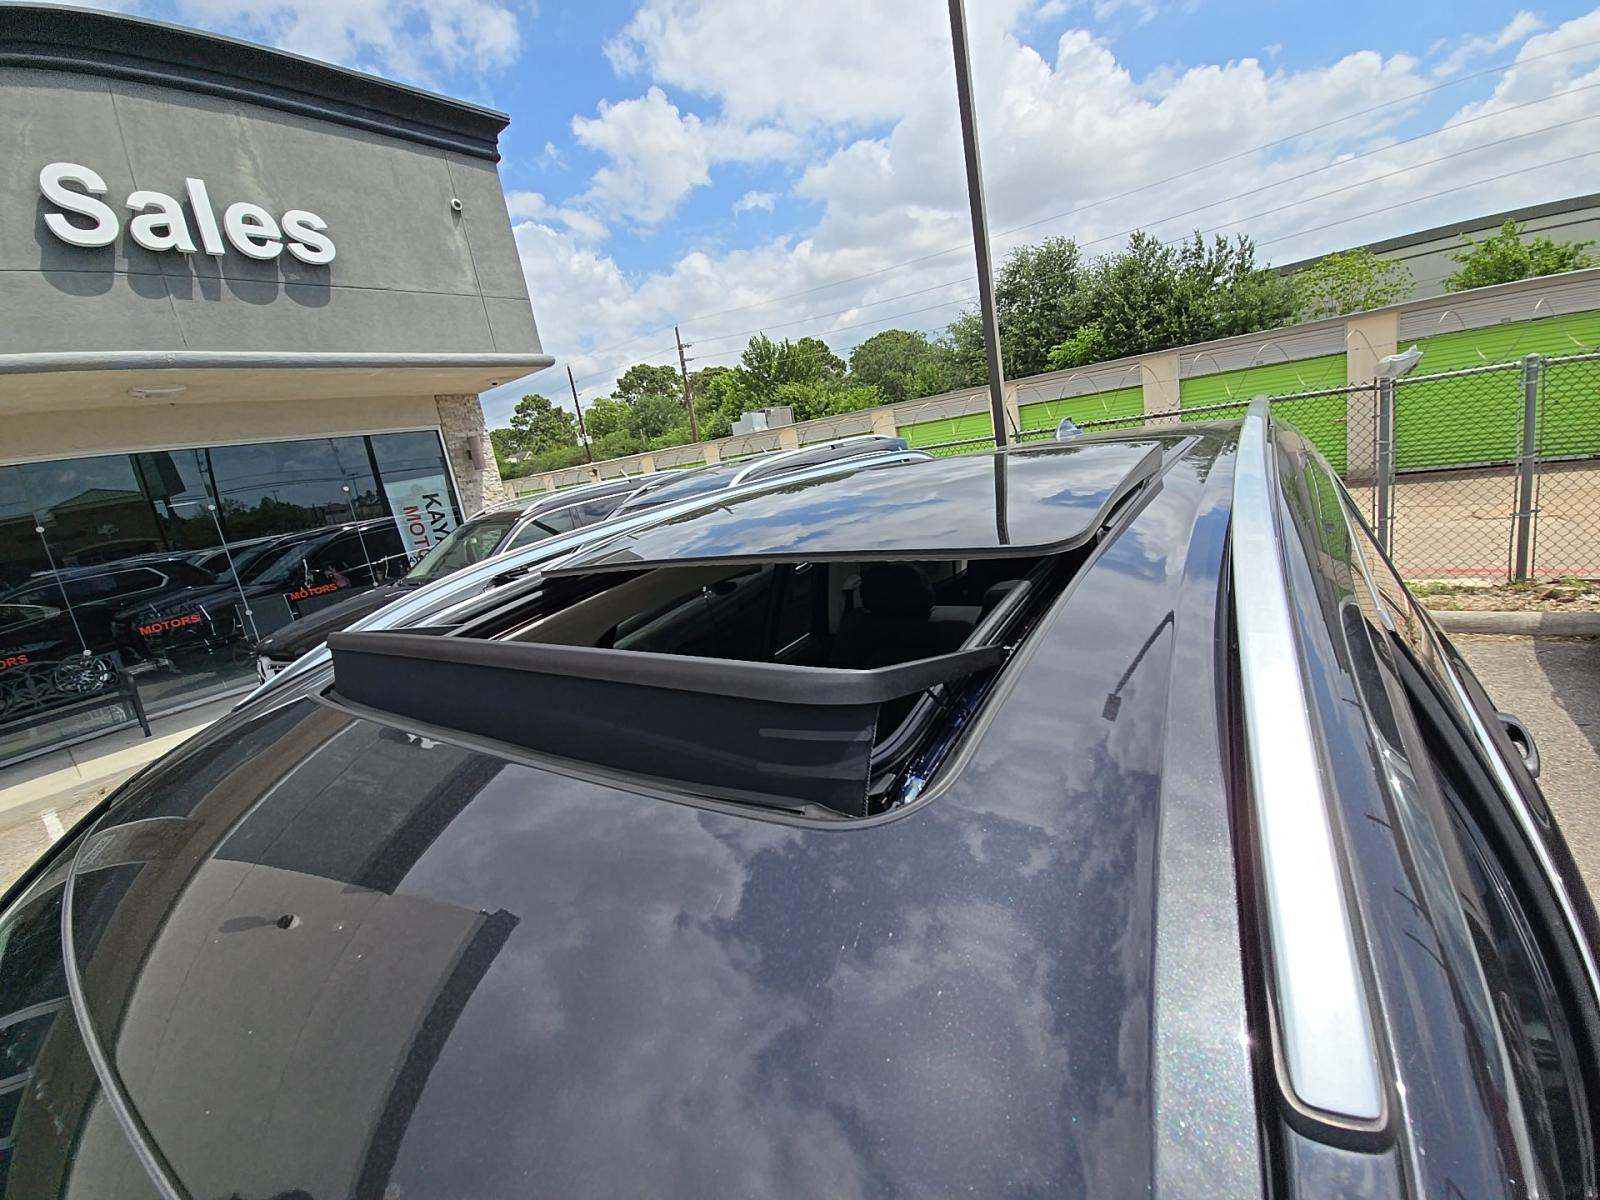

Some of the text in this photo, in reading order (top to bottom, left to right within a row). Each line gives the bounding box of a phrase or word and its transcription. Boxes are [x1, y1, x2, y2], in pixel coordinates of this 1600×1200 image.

[39, 162, 337, 265] Sales
[422, 493, 452, 541] KAY
[289, 583, 338, 601] MOTORS
[137, 613, 203, 637] MOTORS
